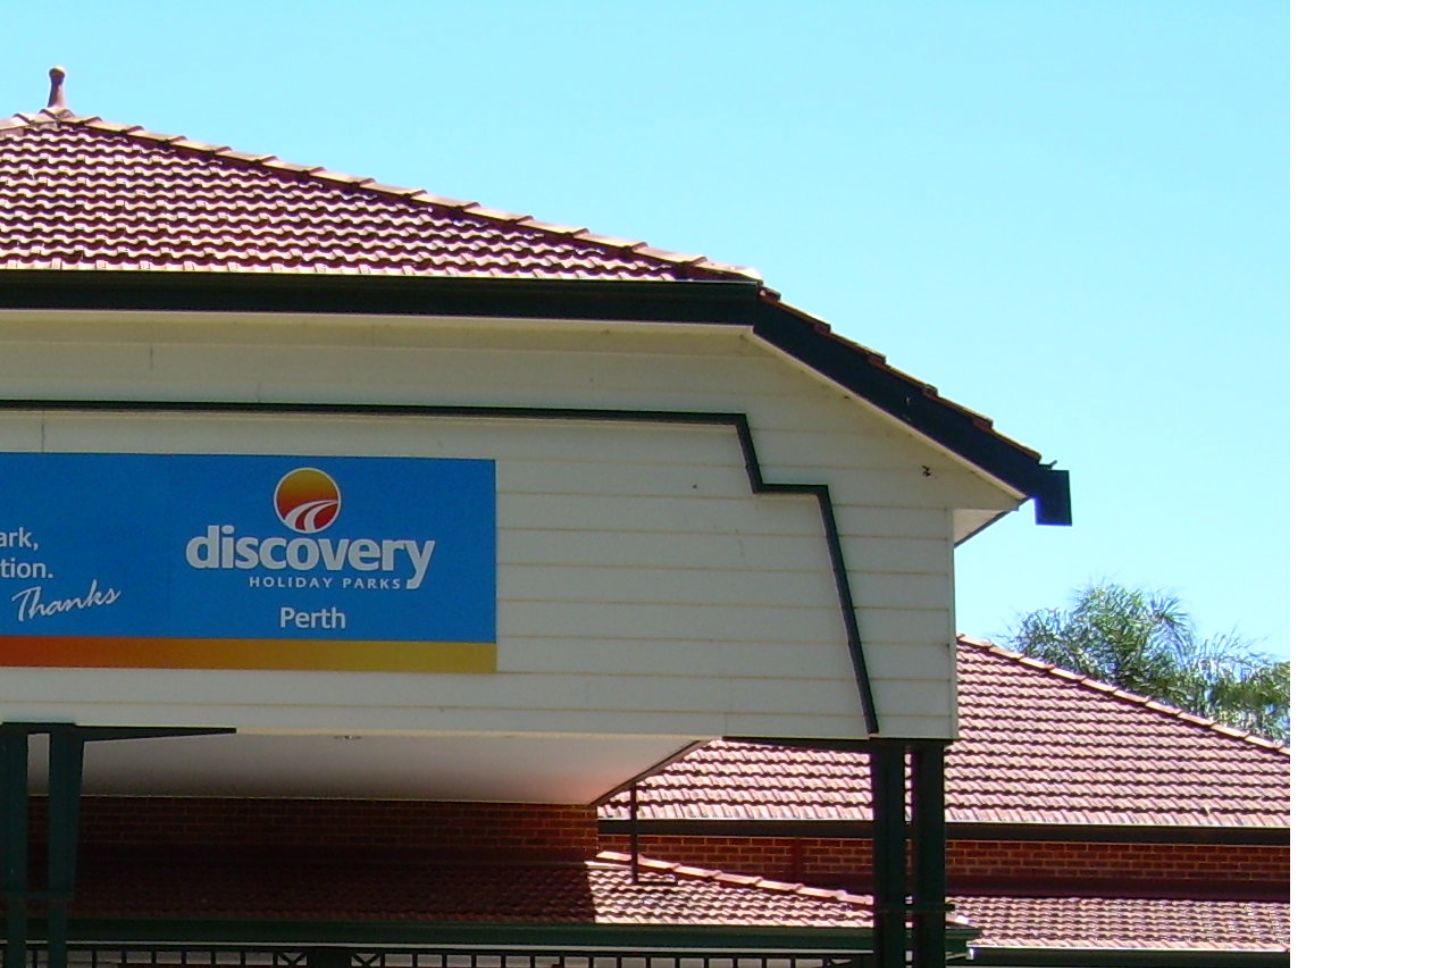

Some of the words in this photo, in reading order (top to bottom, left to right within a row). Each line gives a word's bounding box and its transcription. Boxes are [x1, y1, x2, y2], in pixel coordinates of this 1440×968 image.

[185, 524, 436, 590] discovery
[249, 575, 333, 589] HOLIDAY
[343, 577, 402, 590] PARKS
[11, 580, 121, 622] Thanks
[279, 606, 347, 630] Perth
